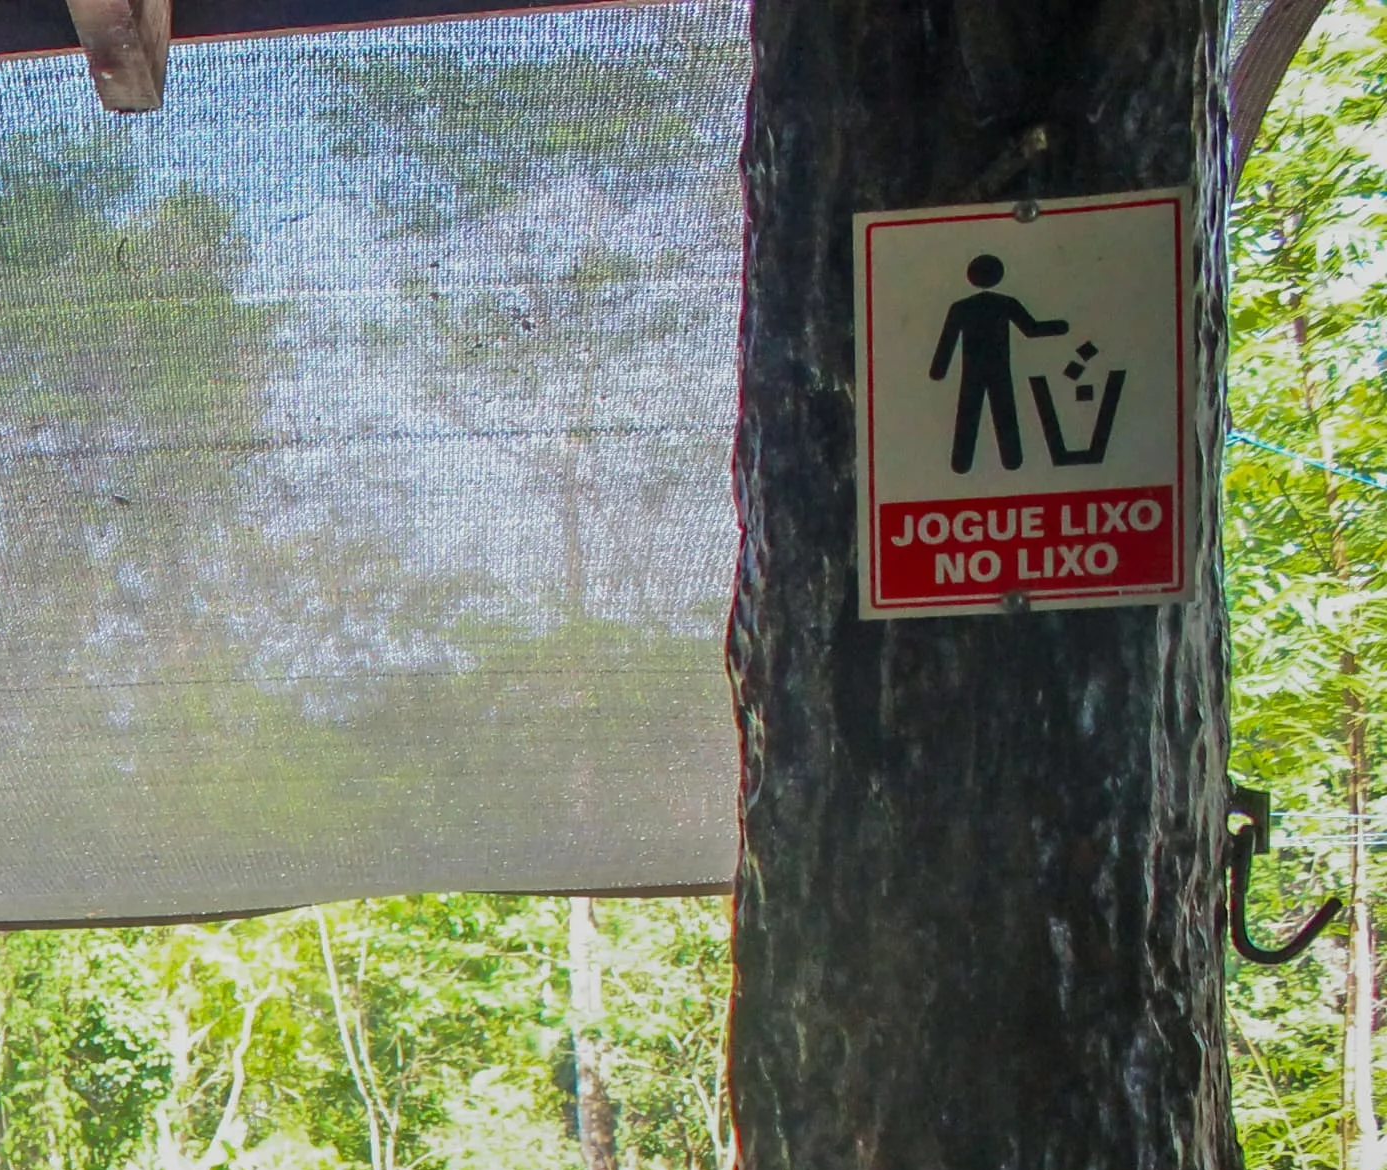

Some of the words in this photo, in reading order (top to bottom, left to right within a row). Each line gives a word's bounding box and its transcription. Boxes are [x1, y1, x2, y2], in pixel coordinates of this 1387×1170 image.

[891, 507, 1045, 547] JOGUE
[1060, 499, 1163, 536] LIXO
[935, 551, 1002, 584] NO
[1017, 543, 1118, 580] LIXO
